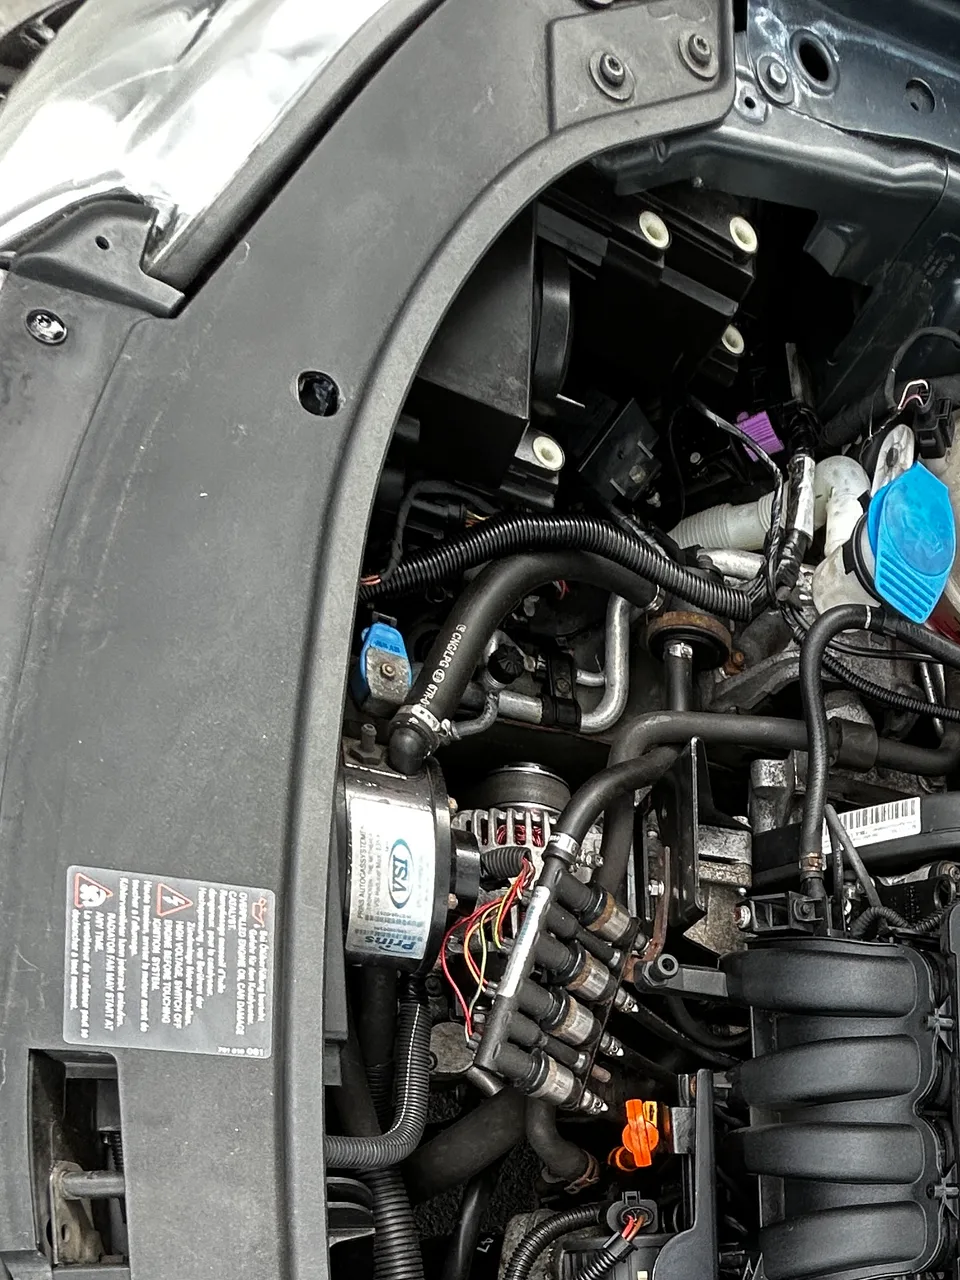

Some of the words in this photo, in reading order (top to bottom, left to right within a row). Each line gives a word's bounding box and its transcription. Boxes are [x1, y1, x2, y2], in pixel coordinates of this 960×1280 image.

[439, 633, 462, 668] CNG/LPG
[392, 854, 408, 892] VSI
[94, 910, 104, 929] ANY
[237, 892, 247, 937] OVERFILLED
[105, 912, 116, 953] RADIATOR
[152, 918, 161, 953] IGNITION
[163, 919, 172, 948] ENGINE
[175, 920, 183, 941] HIGH
[365, 936, 416, 950] Prins
[105, 954, 114, 972] FAN
[162, 950, 172, 980] BEFORE
[237, 938, 246, 967] ENGINE
[104, 973, 114, 990] MAY
[150, 956, 160, 991] SYSTEM.
[236, 968, 245, 981] OIL
[104, 992, 114, 1018] START
[161, 981, 171, 1023] TOUCHING
[173, 980, 182, 1011] SWITCH
[236, 982, 245, 999] CAN
[103, 1019, 113, 1031] AT
[172, 1012, 181, 1028] OFF
[235, 1000, 244, 1035] DAMAGE
